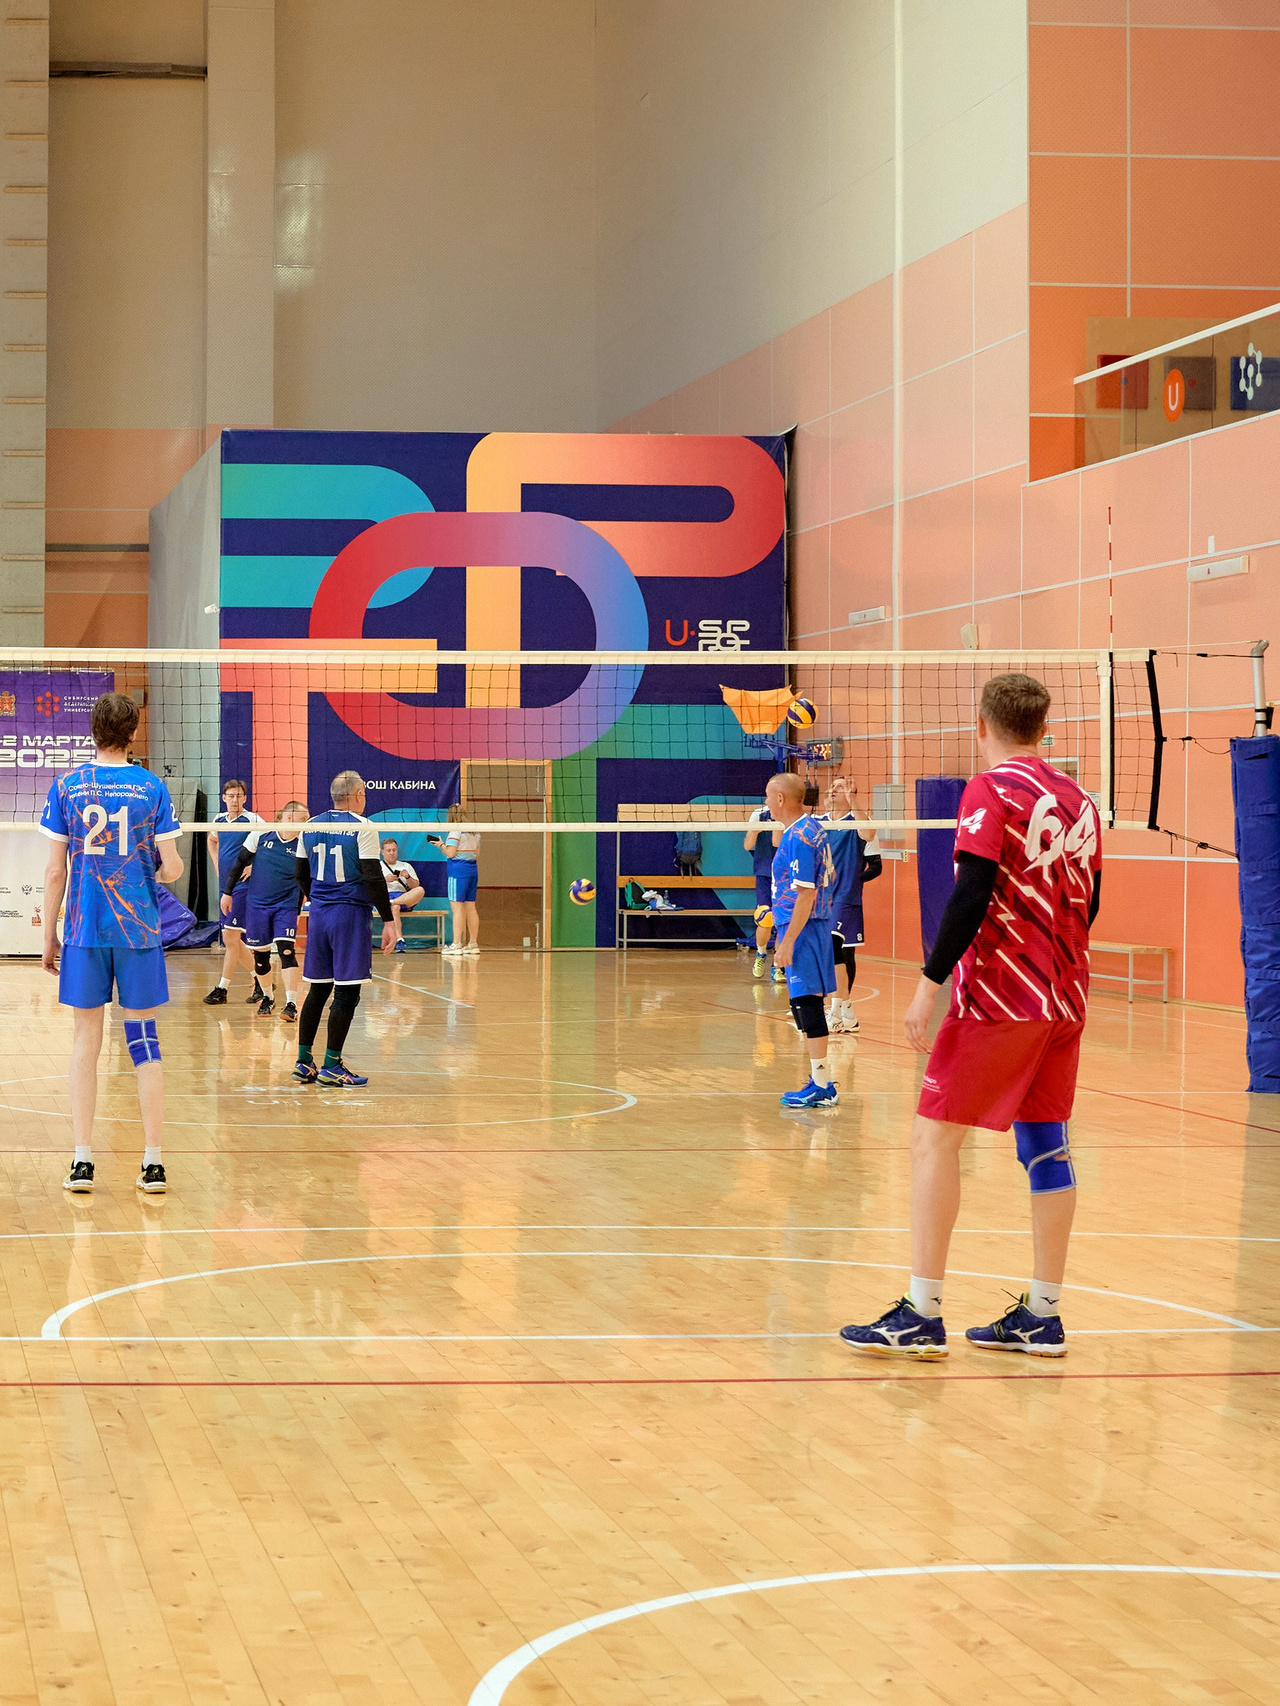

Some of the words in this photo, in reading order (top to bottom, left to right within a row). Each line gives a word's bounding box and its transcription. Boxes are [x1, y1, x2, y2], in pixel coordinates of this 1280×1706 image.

[390, 781, 436, 790] КАБИНА
[82, 804, 128, 856] 21
[1024, 794, 1097, 873] 64
[263, 840, 274, 849] 10
[313, 842, 346, 882] 11
[232, 917, 238, 925] 4
[836, 921, 843, 930] 7
[285, 928, 295, 937] 10
[856, 933, 863, 941] 8
